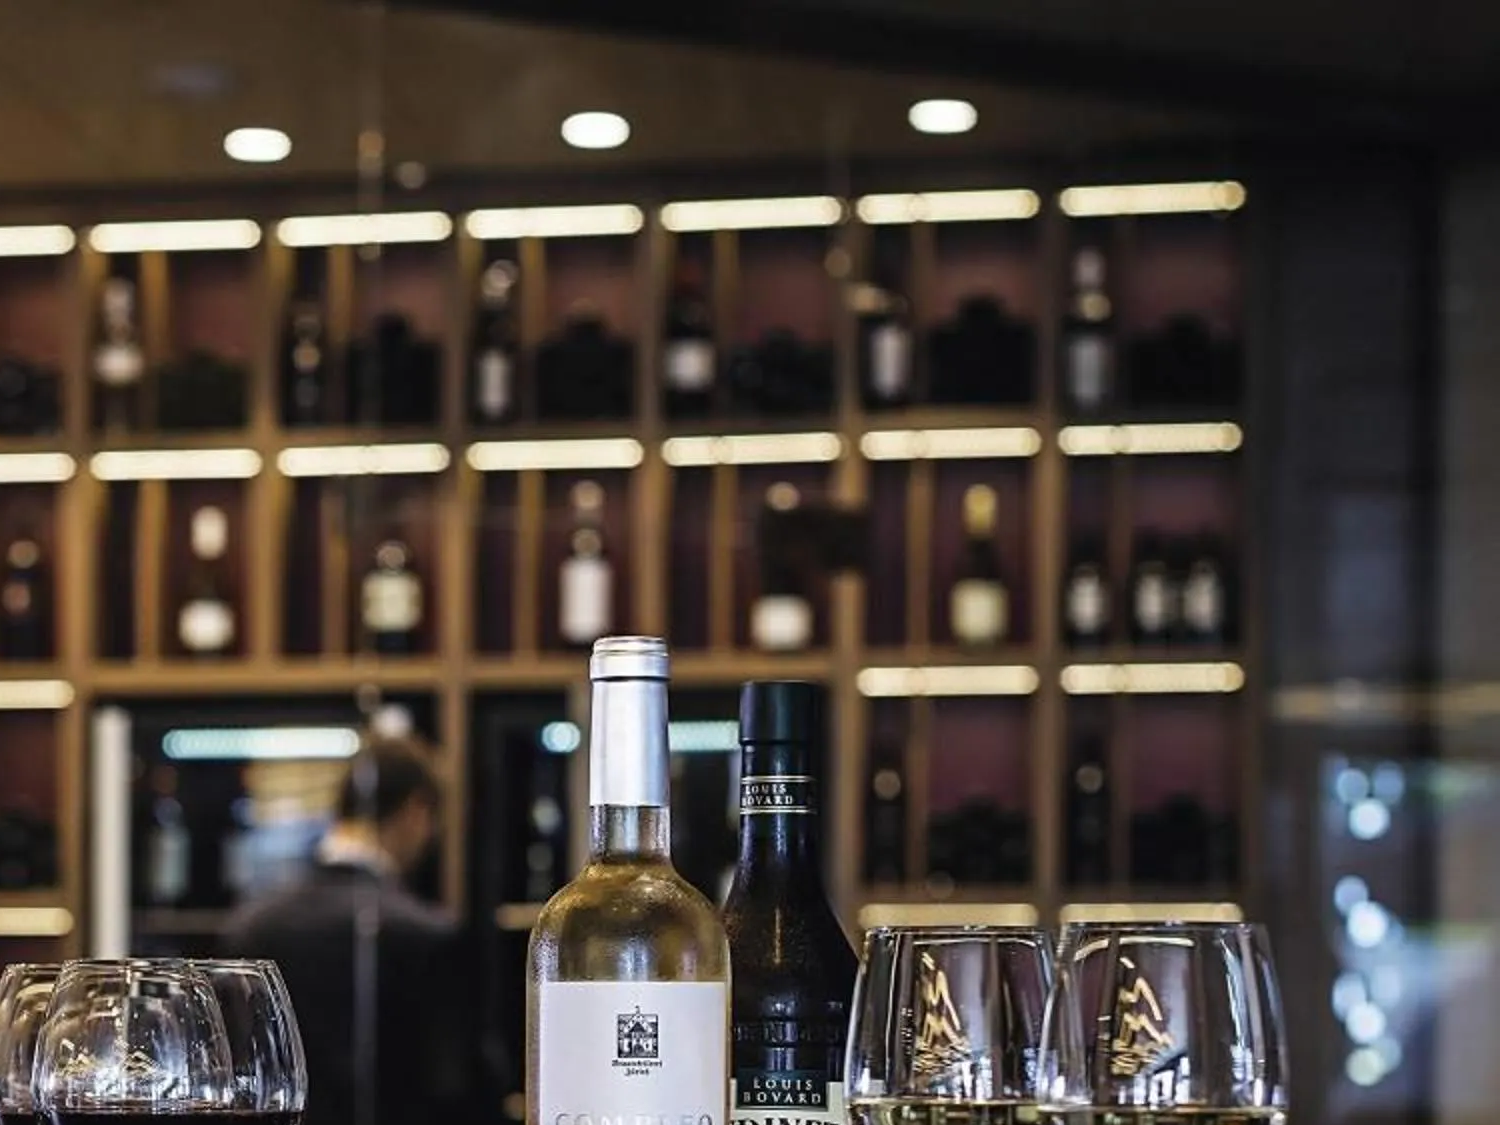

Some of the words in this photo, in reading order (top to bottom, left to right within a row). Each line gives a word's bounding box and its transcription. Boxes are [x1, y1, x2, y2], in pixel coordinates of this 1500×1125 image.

[745, 783, 787, 795] LOUIS
[753, 1078, 813, 1091] LOUIS
[743, 1091, 821, 1104] BOVARD
